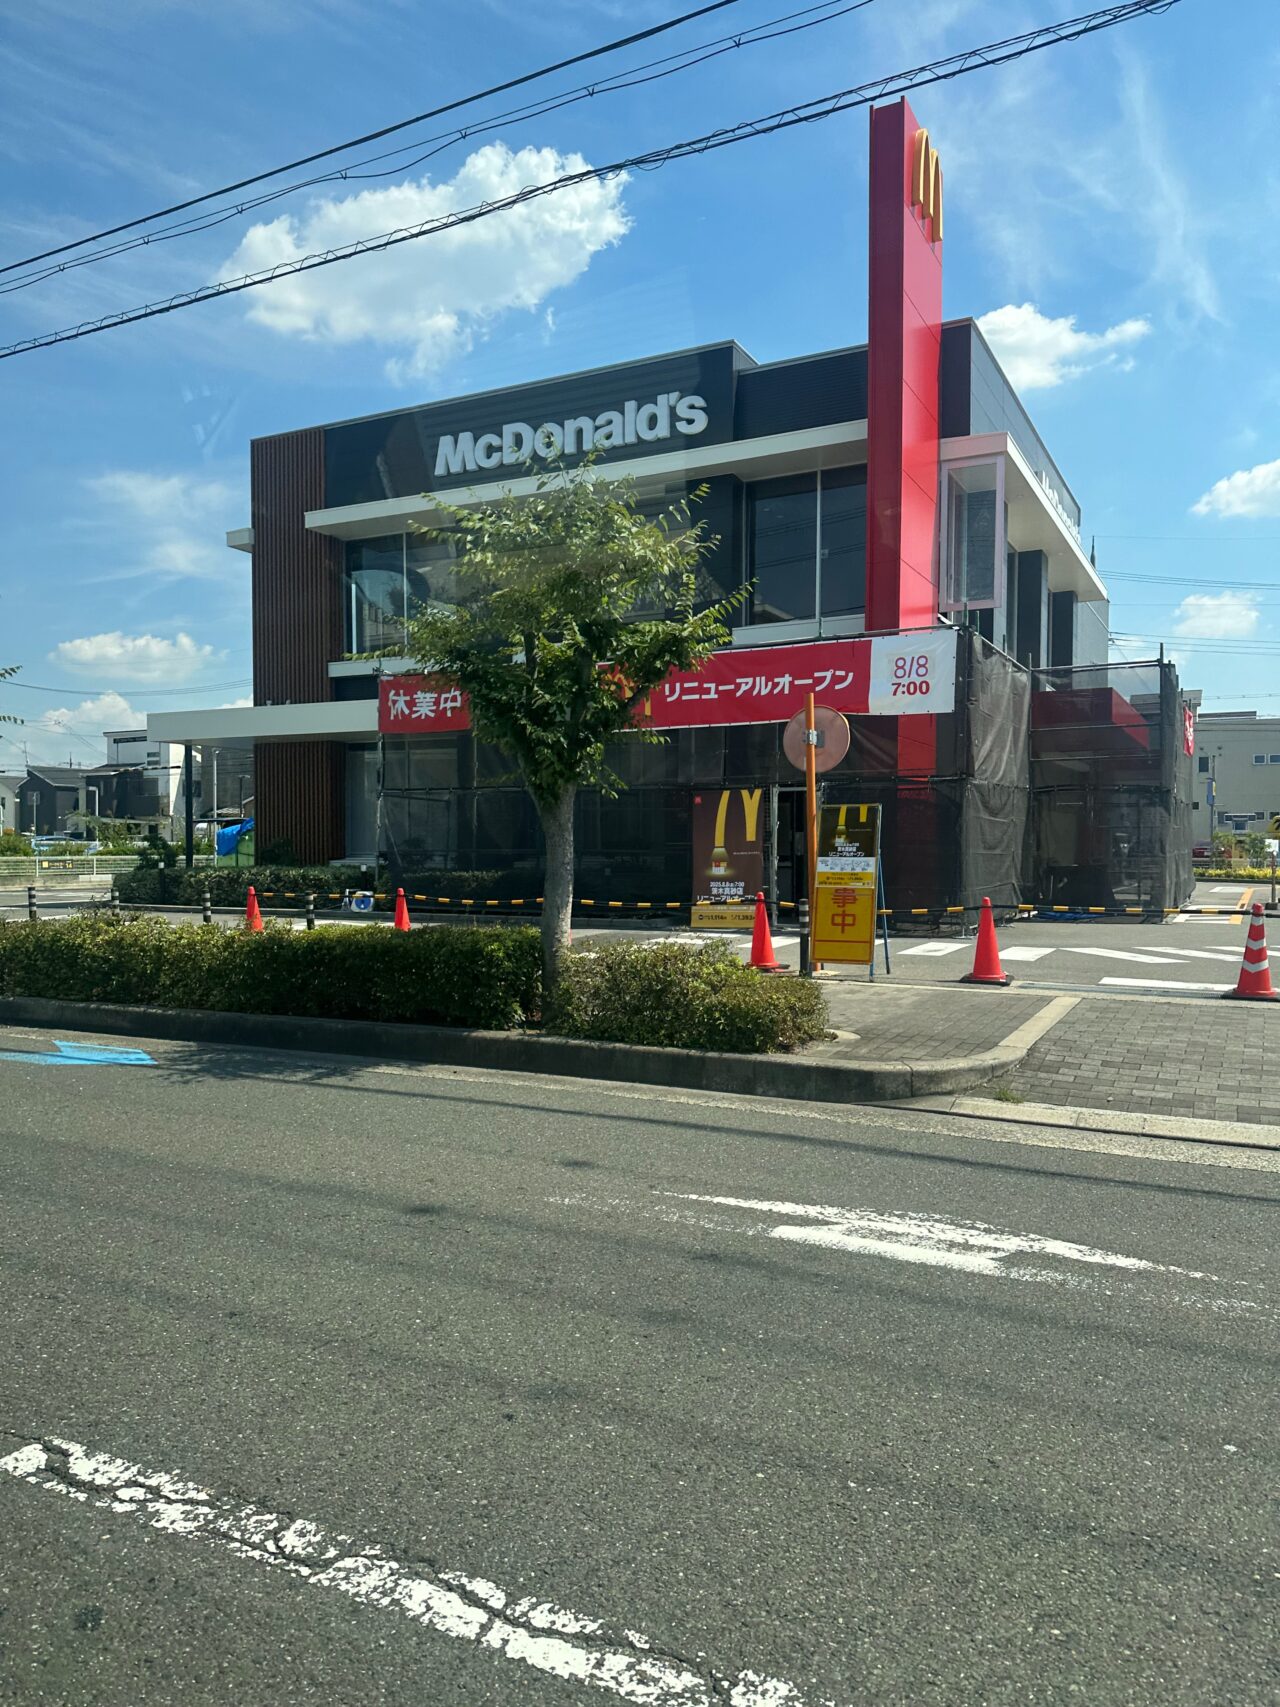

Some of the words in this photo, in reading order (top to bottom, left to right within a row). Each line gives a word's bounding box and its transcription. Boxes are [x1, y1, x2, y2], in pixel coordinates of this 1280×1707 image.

[434, 391, 709, 477] McDonald's
[893, 655, 929, 679] 8/8
[665, 669, 854, 702] リニューアルオープン
[891, 680, 930, 696] 7:00
[388, 687, 462, 720] 休業中
